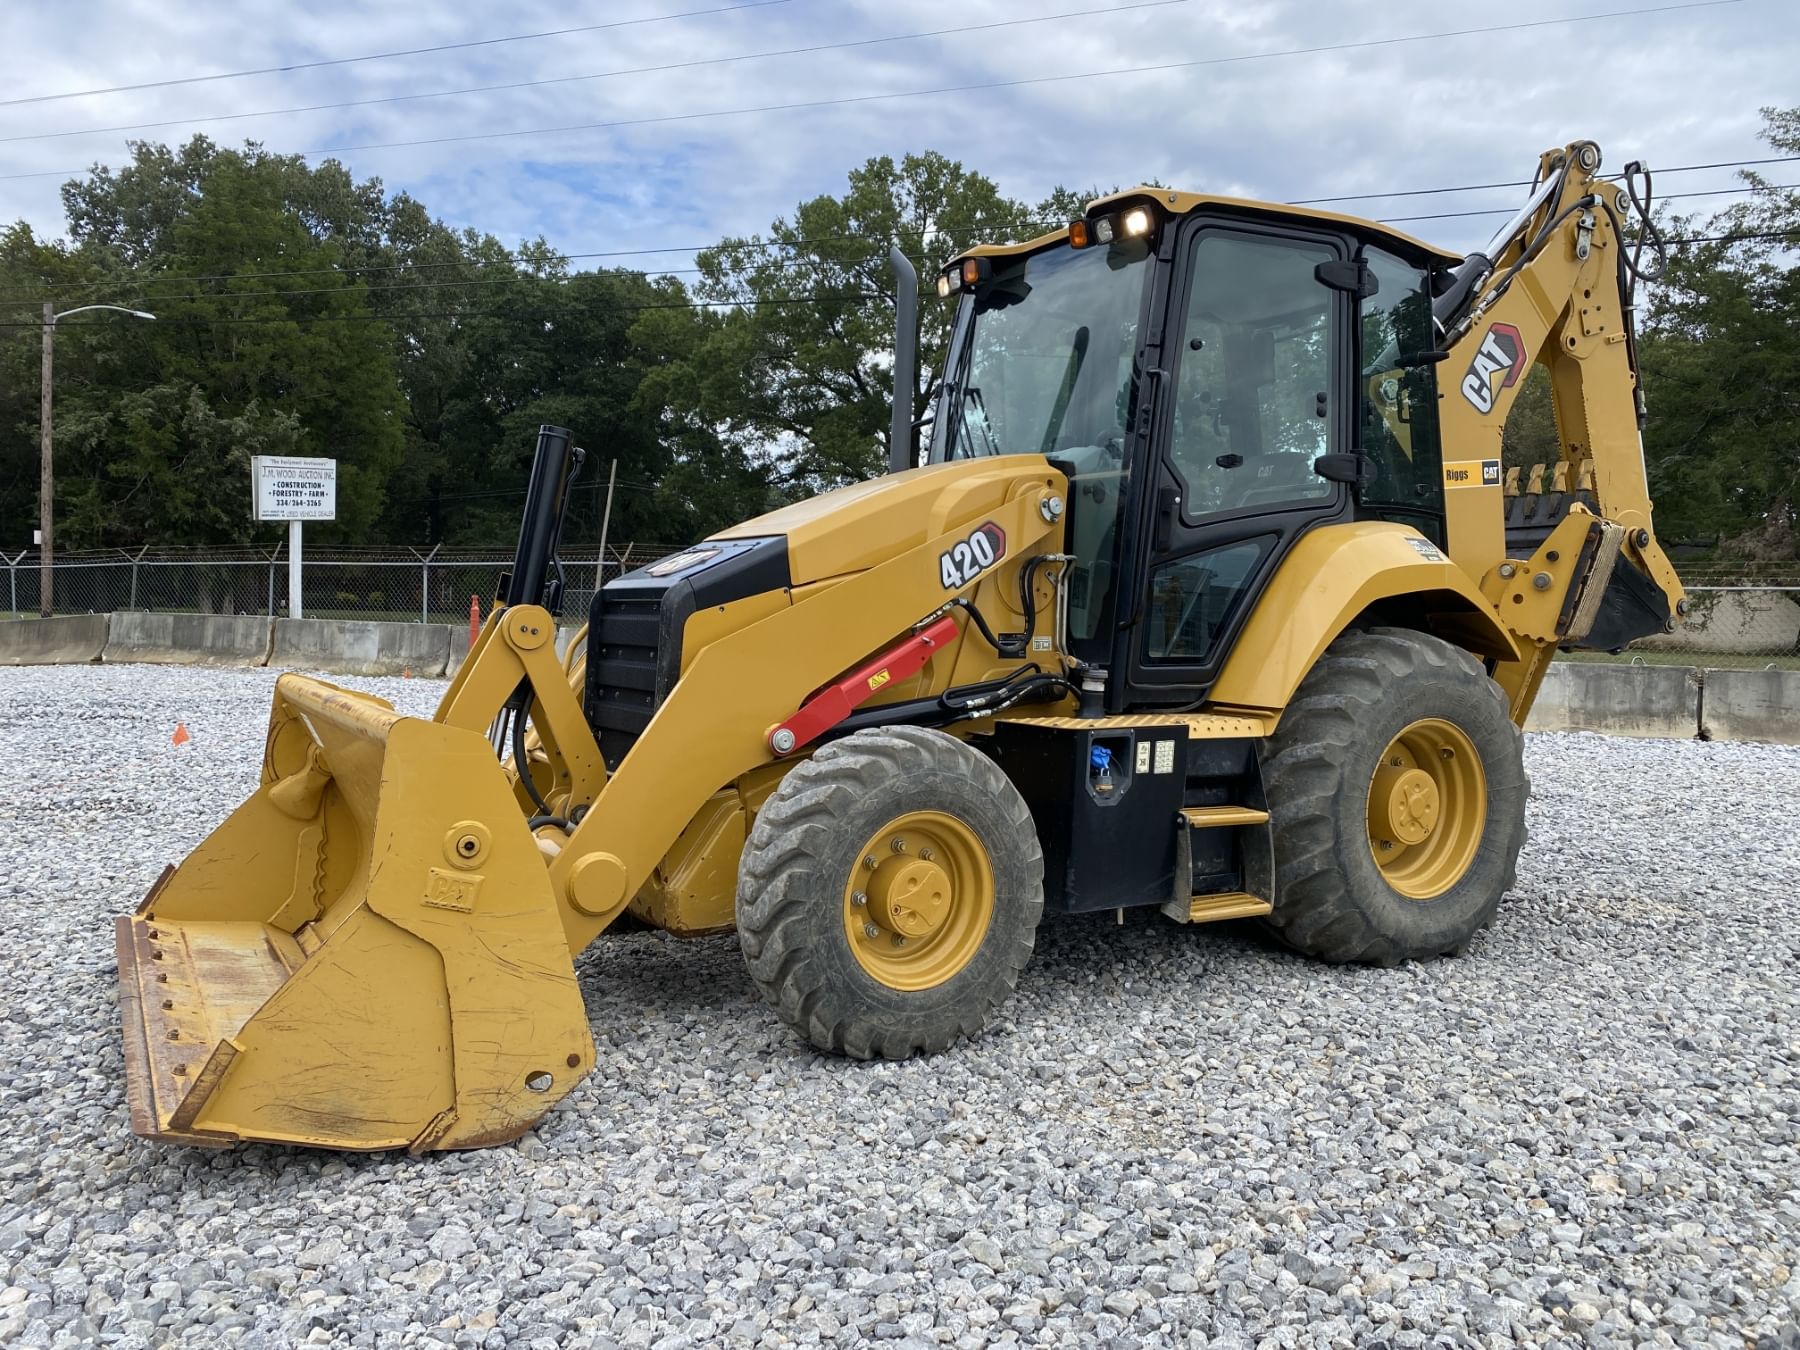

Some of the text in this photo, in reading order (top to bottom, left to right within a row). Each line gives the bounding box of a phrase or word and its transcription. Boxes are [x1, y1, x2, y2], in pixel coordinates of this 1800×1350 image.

[1462, 331, 1513, 413] CAT
[276, 469, 296, 479] WOOD
[298, 470, 322, 480] AUCTION
[1446, 466, 1498, 481] Riggs CAT
[277, 481, 322, 489] CONSTRUCTION
[308, 490, 325, 498] FARM
[276, 499, 322, 507] 334/264-3265
[941, 531, 994, 588] 420
[431, 877, 475, 906] CAT
